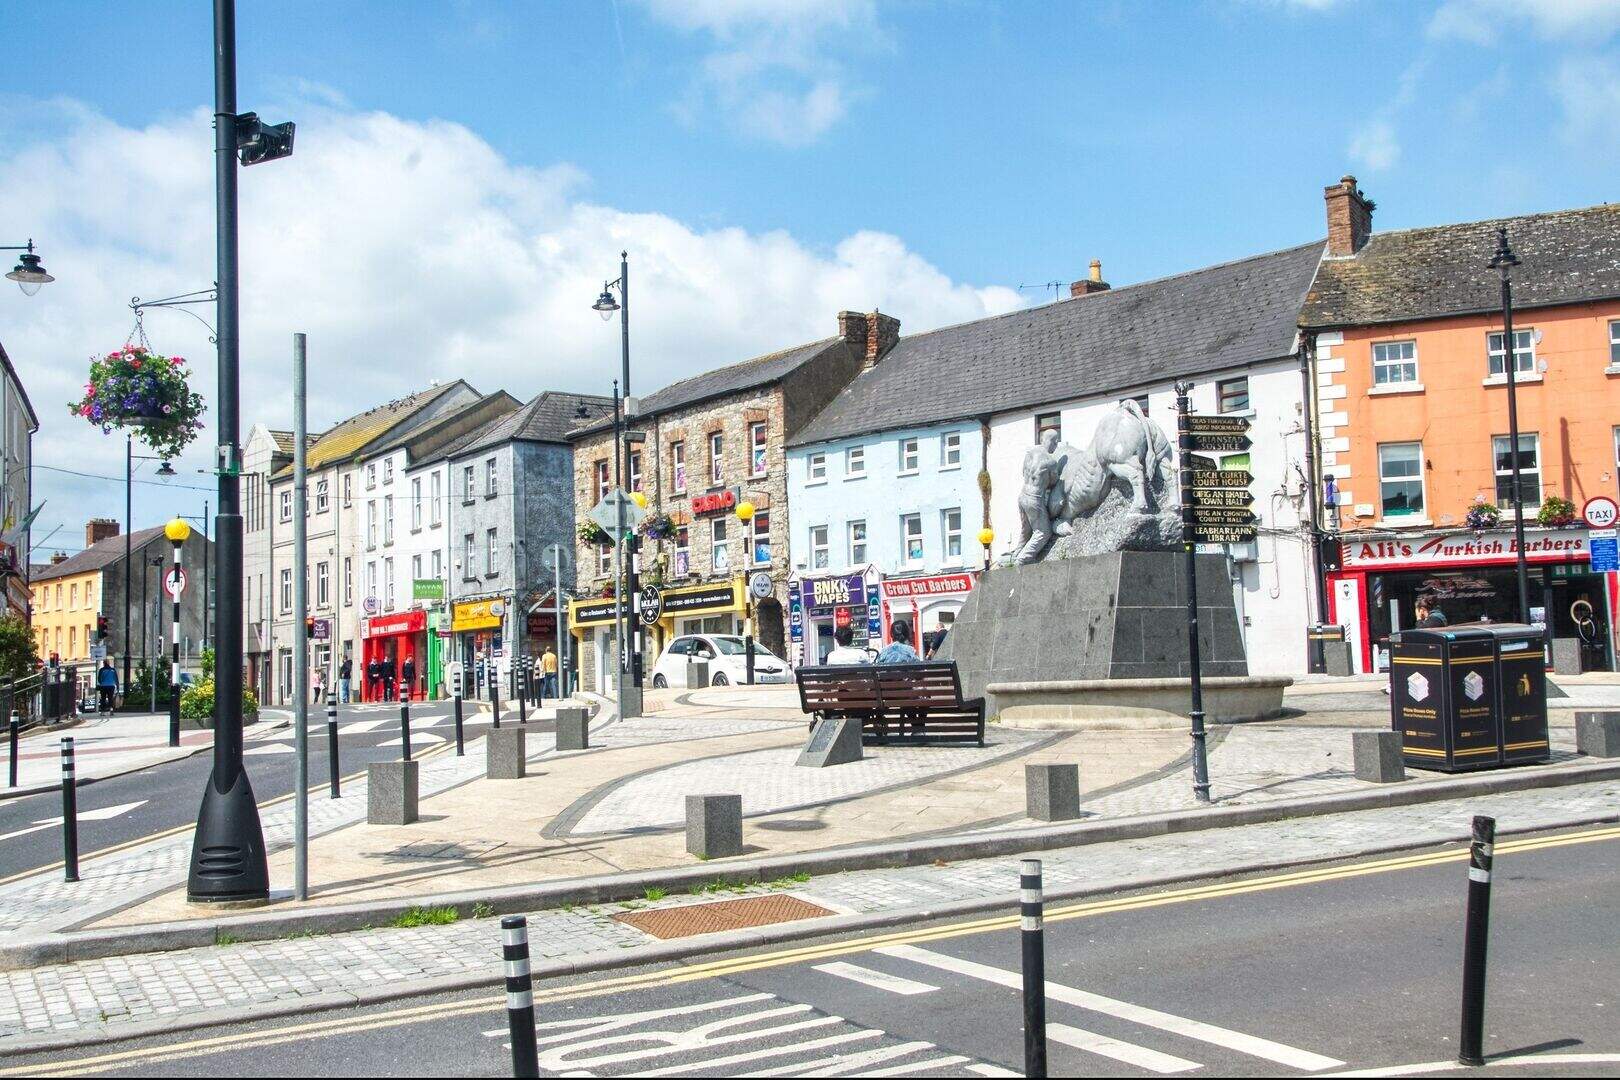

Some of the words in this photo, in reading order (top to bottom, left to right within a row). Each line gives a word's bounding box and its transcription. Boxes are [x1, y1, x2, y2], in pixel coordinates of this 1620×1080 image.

[1192, 478, 1219, 486] COURT
[1221, 478, 1248, 486] HOUSE
[1212, 490, 1224, 498] AN
[692, 491, 736, 513] CASINO
[1588, 509, 1613, 520] TAXI
[1195, 527, 1253, 535] LEABHARLANN
[1207, 534, 1241, 542] LIBRARY
[1359, 541, 1413, 560] Ali's
[1508, 538, 1583, 553] Barbers
[886, 583, 910, 596] Crew
[912, 581, 928, 594] Cut
[929, 578, 967, 593] Barbers
[815, 592, 850, 605] VAPES
